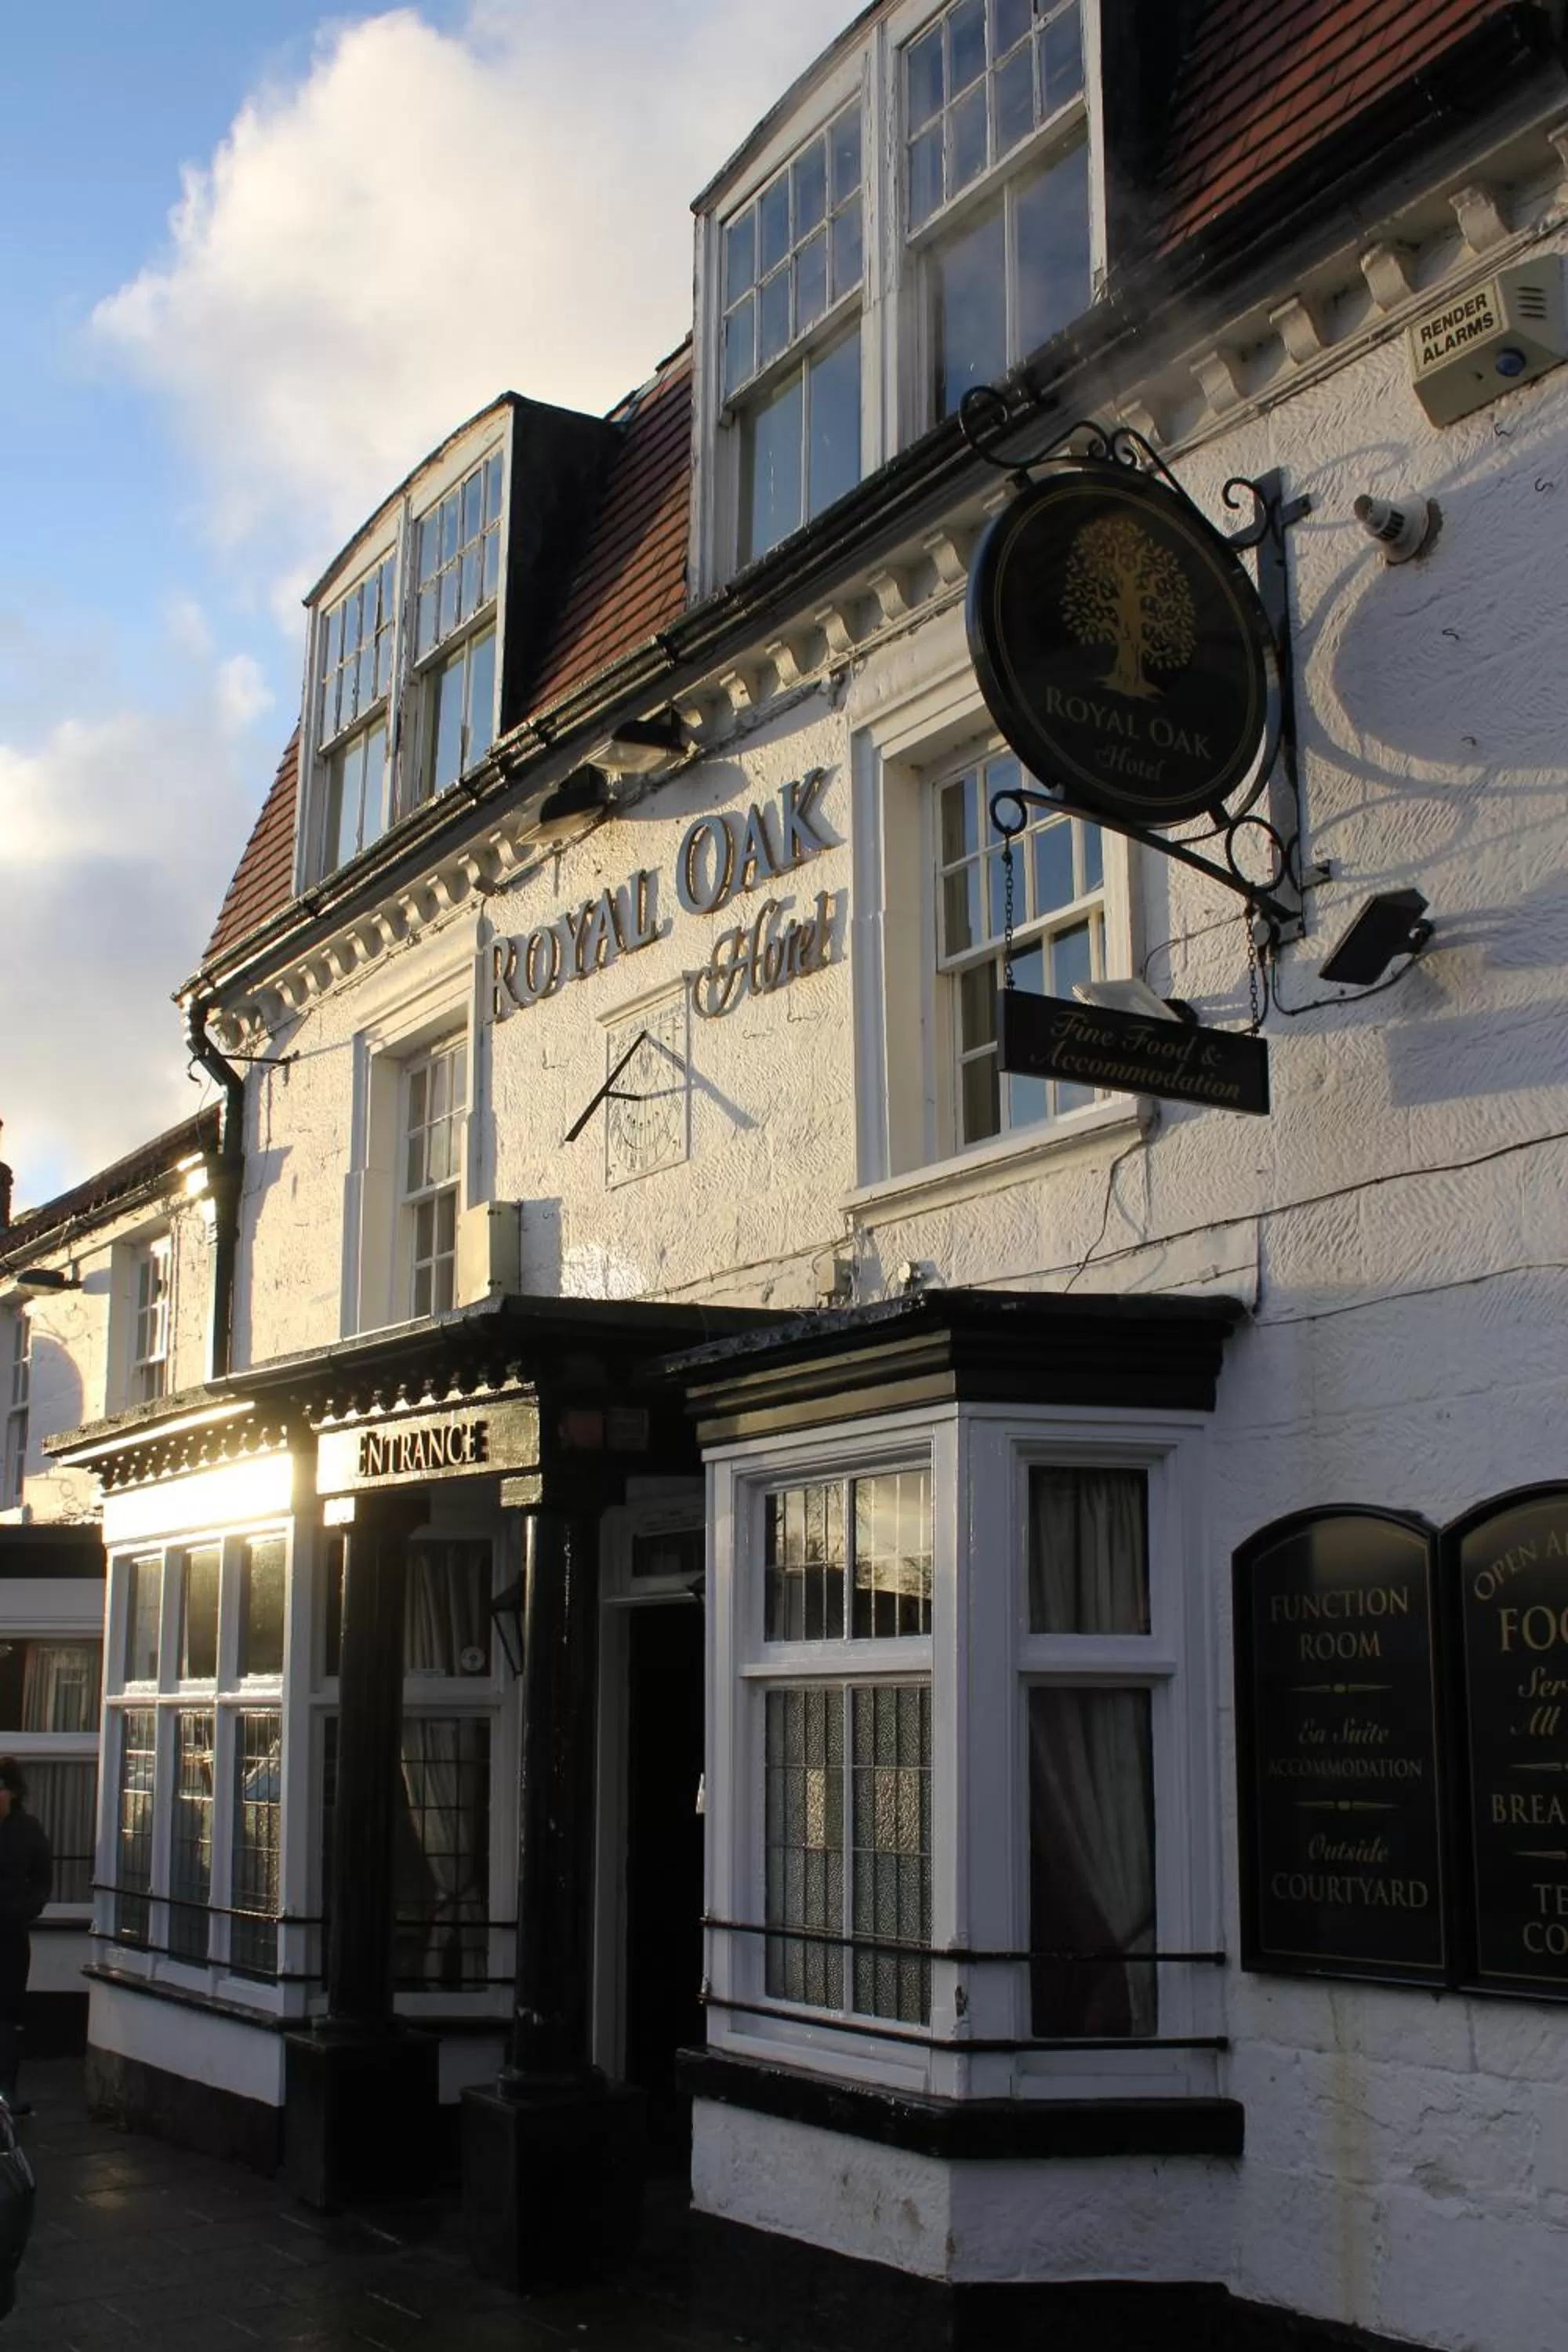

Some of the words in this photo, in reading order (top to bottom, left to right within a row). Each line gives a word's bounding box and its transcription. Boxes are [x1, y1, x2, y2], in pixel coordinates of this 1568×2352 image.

[1421, 293, 1487, 343] RENDER
[1423, 312, 1494, 365] ALARMS
[1046, 685, 1139, 741] ROYAL
[1149, 717, 1212, 760] OAK
[1095, 745, 1167, 782] Hotel
[482, 869, 657, 1024] ROYAL
[676, 768, 837, 915] OAK
[694, 891, 837, 1018] Hotel
[1050, 1011, 1116, 1047] Fine
[1122, 1025, 1197, 1062] Food
[1201, 1045, 1222, 1067] &
[1030, 1040, 1242, 1099] Accommodation
[358, 1421, 478, 1476] ENTRANCE
[1473, 1541, 1537, 1600] OPEN
[1270, 1586, 1408, 1624] FUNCTION
[1299, 1629, 1382, 1661] ROOM
[1332, 1717, 1392, 1745] Suite
[1268, 1756, 1425, 1781] ACCOMMODATION
[1307, 1831, 1391, 1865] Outside
[1272, 1872, 1429, 1908] COURTYARD
